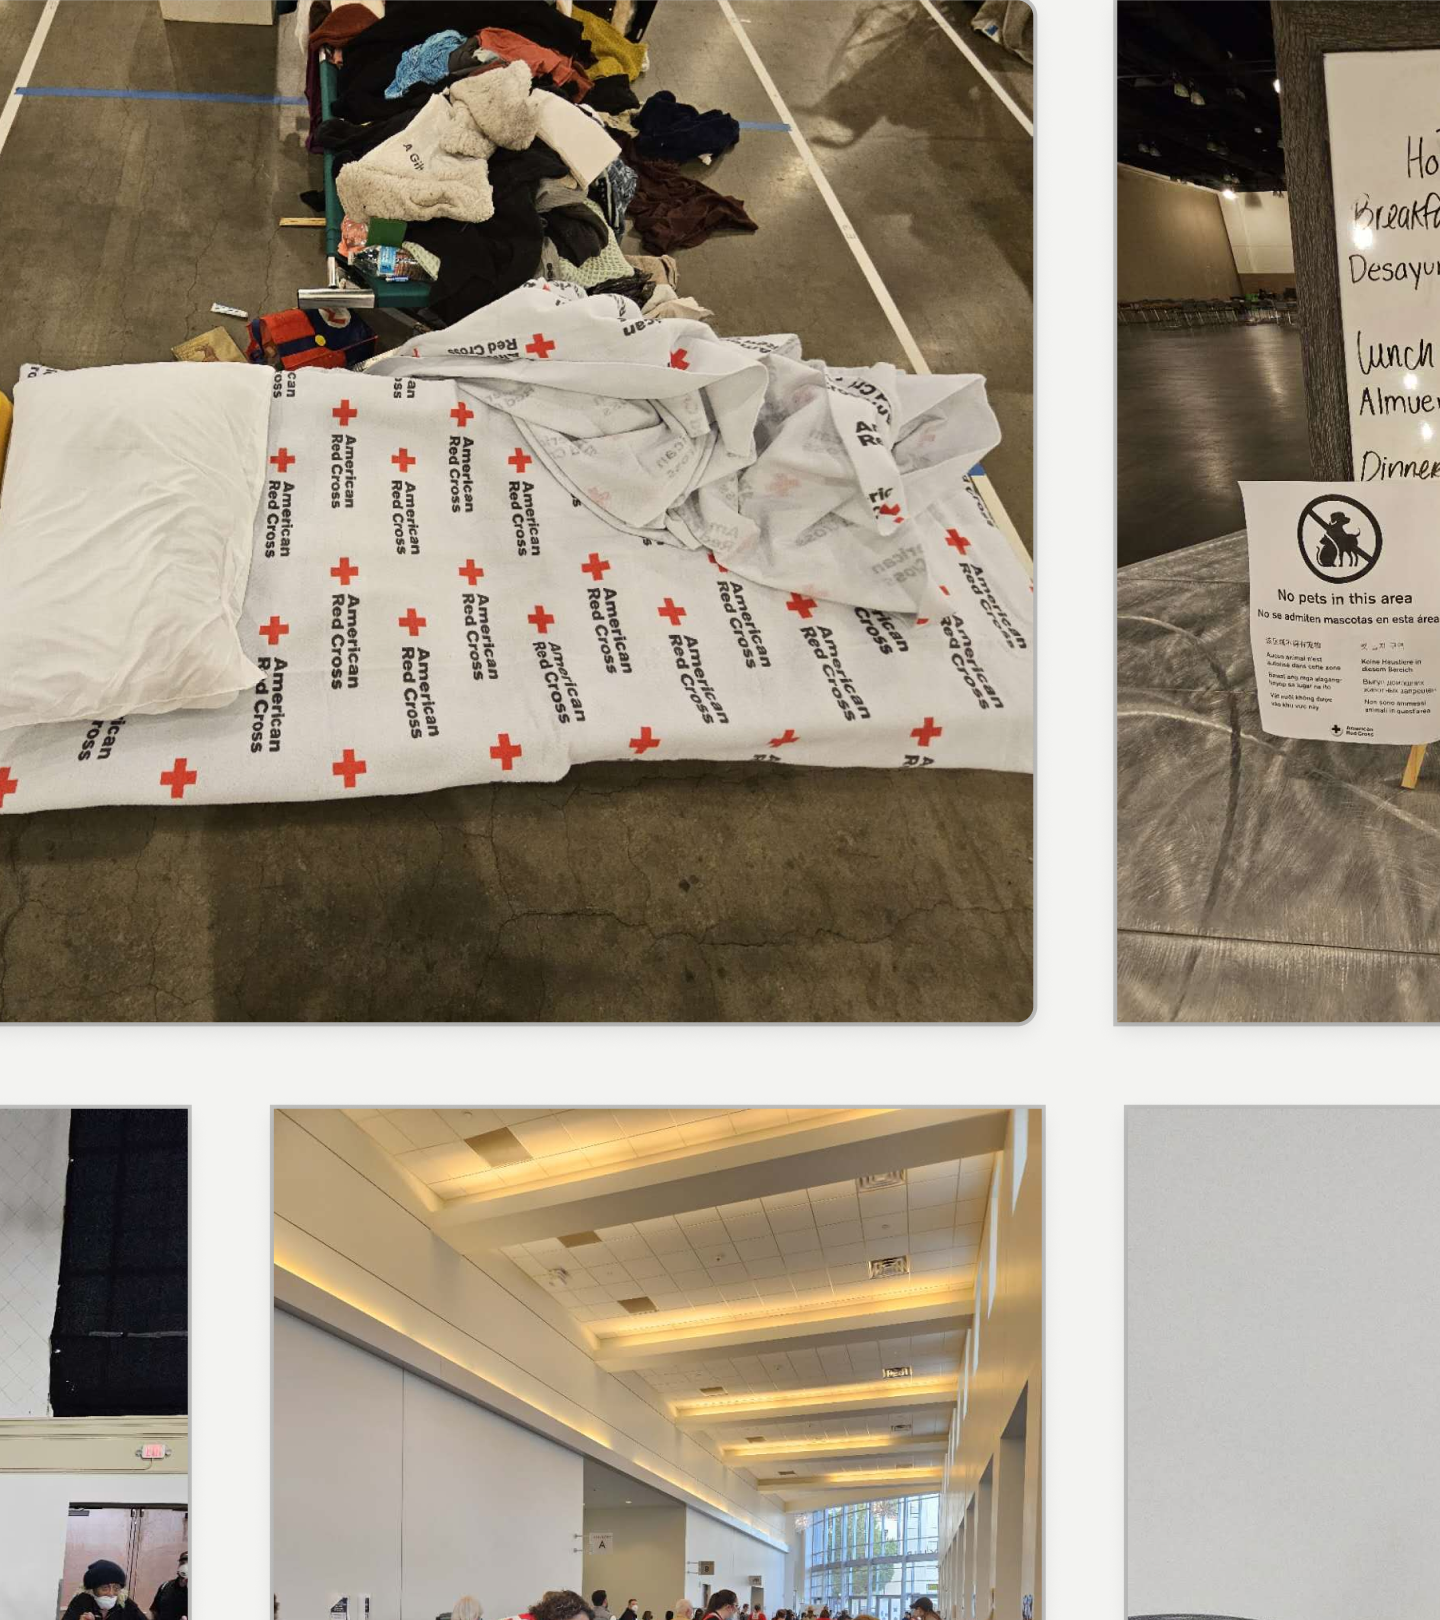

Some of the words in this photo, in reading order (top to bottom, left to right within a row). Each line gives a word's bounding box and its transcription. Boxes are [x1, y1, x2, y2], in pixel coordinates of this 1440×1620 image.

[487, 338, 518, 351] Red
[331, 434, 343, 460] Red
[345, 436, 357, 509] American
[449, 435, 461, 465] Red
[268, 480, 281, 508] Red
[331, 463, 343, 509] Cross
[391, 480, 403, 510] Red
[449, 468, 461, 513] Cross
[463, 437, 475, 513] American
[508, 481, 521, 511] Red
[265, 512, 280, 559] Cross
[280, 481, 295, 557] American
[392, 512, 406, 555] Cross
[405, 482, 420, 555] American
[512, 513, 527, 557] Cross
[522, 481, 540, 556] American
[331, 594, 345, 630] Red
[462, 593, 476, 626] Red
[587, 588, 604, 621] Red
[1257, 608, 1270, 619] No
[1271, 611, 1283, 621] se
[1284, 612, 1322, 625] admiten
[1323, 614, 1374, 625] mascotas
[1375, 616, 1390, 625] en
[1391, 615, 1415, 624] esta
[1416, 613, 1440, 624] área
[1277, 588, 1295, 602] No
[1298, 591, 1328, 606] pets
[1331, 592, 1345, 606] in
[1348, 592, 1377, 605] this
[1380, 593, 1414, 605] area
[348, 594, 360, 689] American
[476, 593, 499, 680] American
[594, 623, 617, 674] Cross
[603, 588, 633, 674] American
[716, 580, 737, 614] Red
[729, 617, 756, 669] Cross
[729, 581, 772, 668] American
[854, 606, 893, 655] Cross
[331, 634, 345, 690] Cross
[401, 646, 416, 683] Red
[466, 630, 484, 681] Cross
[668, 634, 690, 670] Red
[680, 673, 715, 725] Cross
[683, 635, 730, 724] American
[800, 626, 826, 660] Red
[822, 663, 856, 722] Cross
[817, 625, 871, 720] American
[269, 657, 288, 753] American
[403, 687, 422, 739] Cross
[417, 647, 440, 737] American
[250, 698, 269, 754] Cross
[598, 1540, 606, 1550] A
